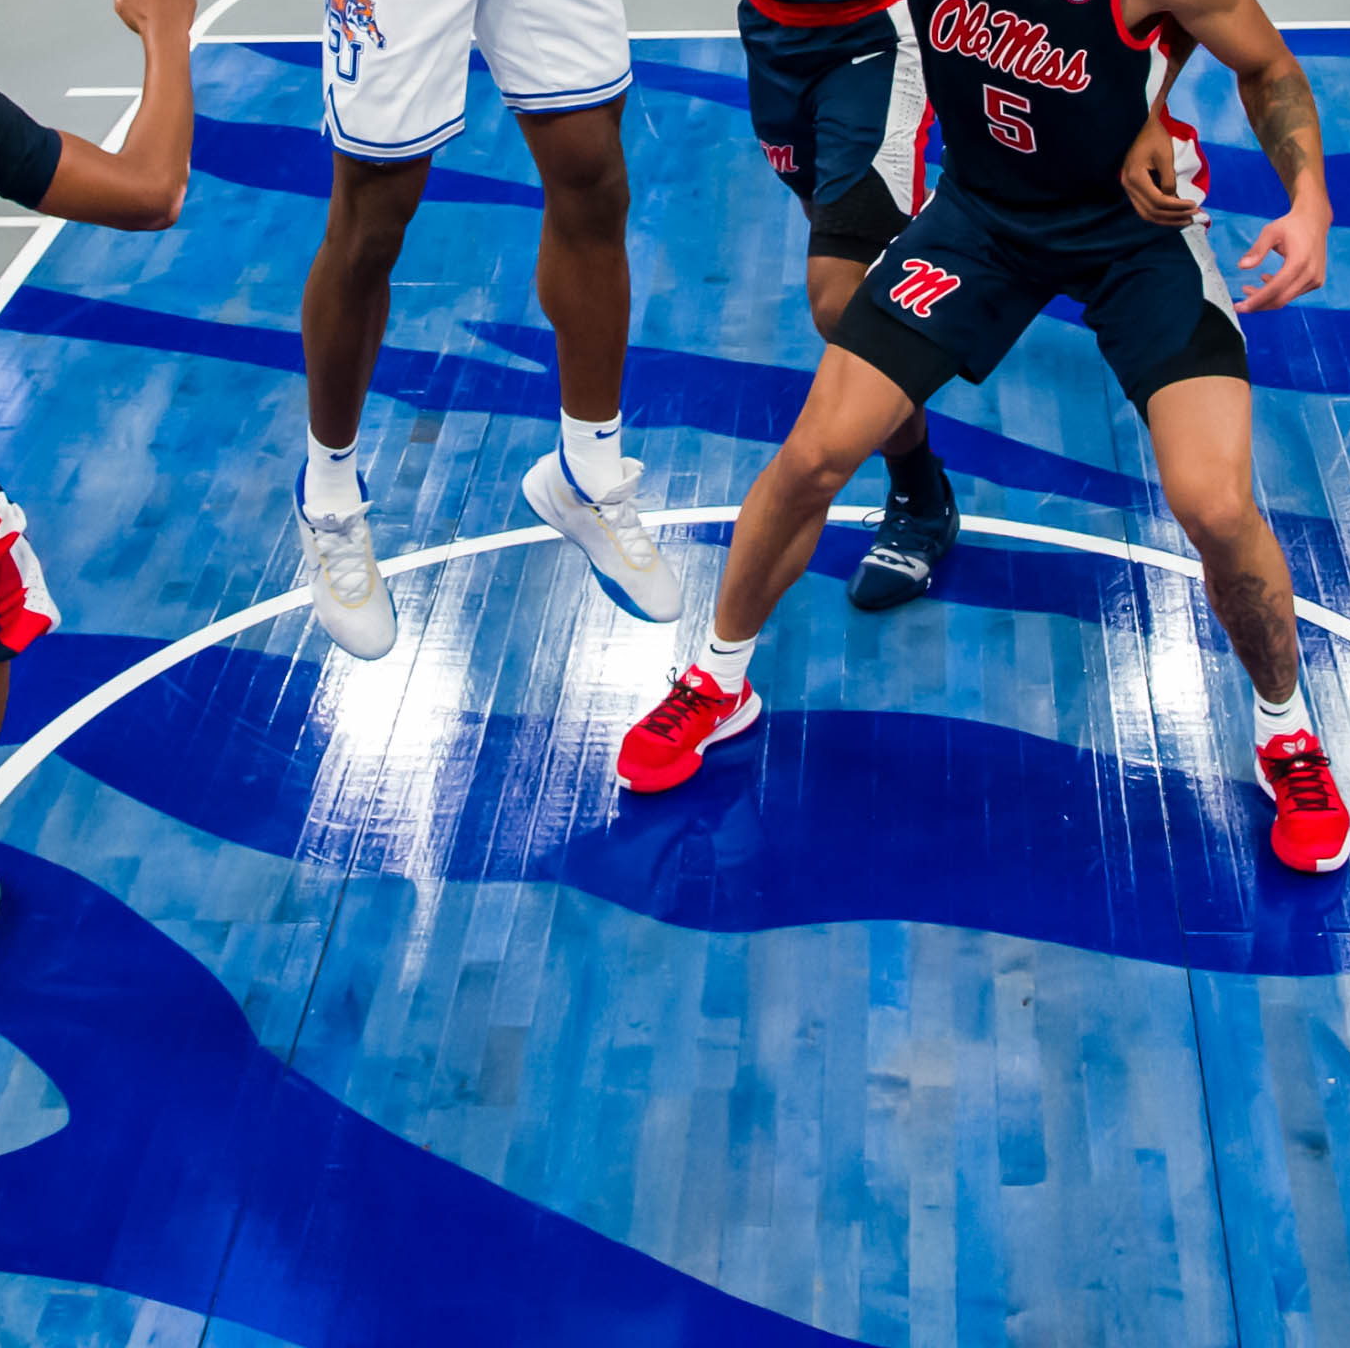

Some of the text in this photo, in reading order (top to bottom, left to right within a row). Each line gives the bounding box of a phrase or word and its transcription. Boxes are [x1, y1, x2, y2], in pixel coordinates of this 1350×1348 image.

[988, 10, 1091, 93] Miss
[983, 84, 1037, 153] 5
[890, 259, 961, 318] M
